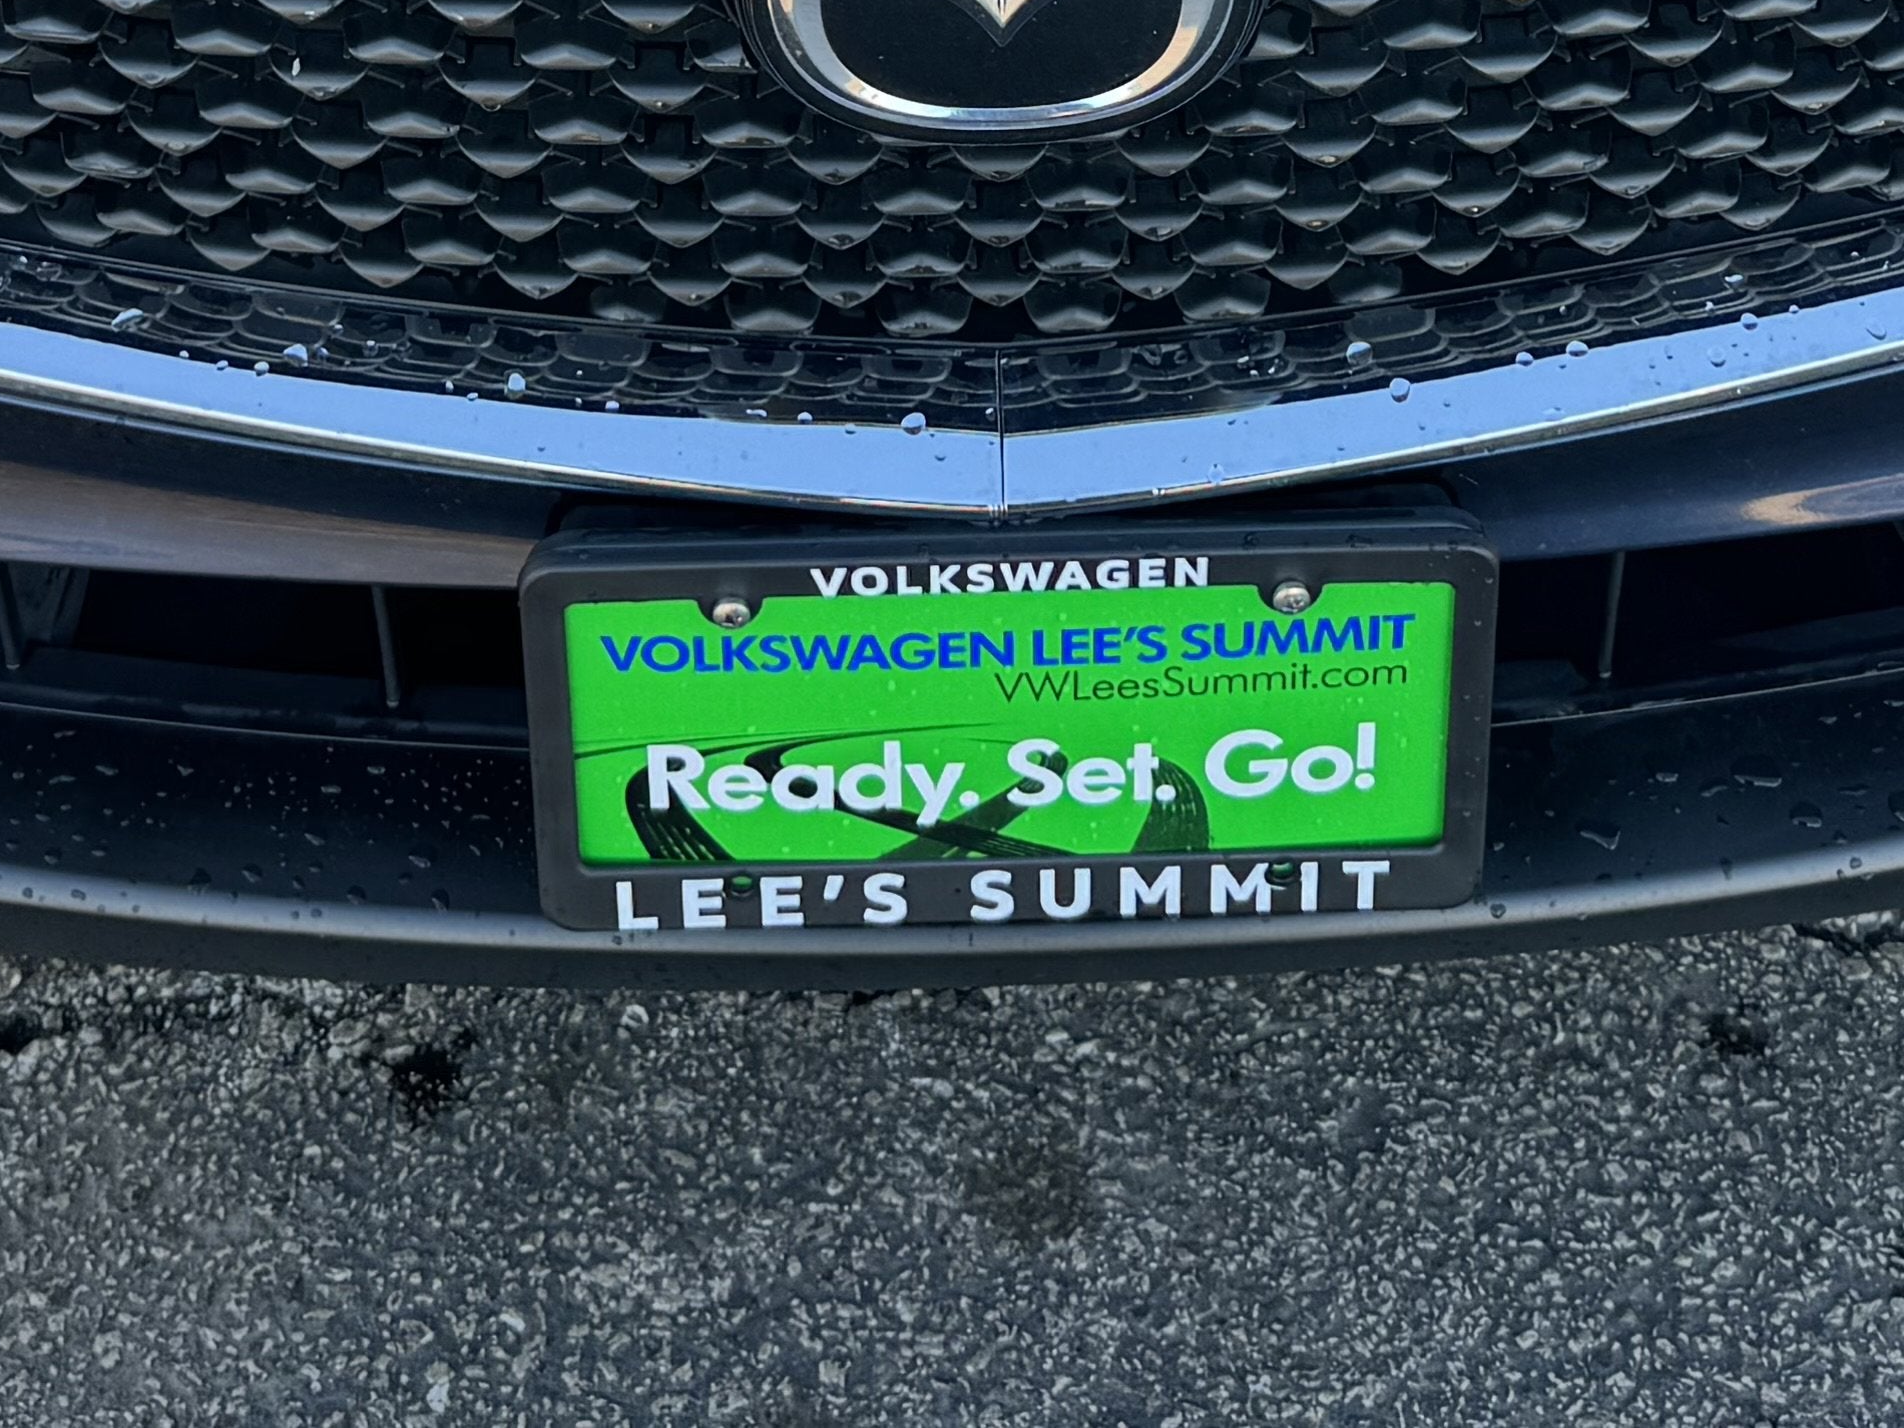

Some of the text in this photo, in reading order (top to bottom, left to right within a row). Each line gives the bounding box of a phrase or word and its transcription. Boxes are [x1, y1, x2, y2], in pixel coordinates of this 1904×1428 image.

[810, 556, 1210, 599] VOLKSWAGEN
[599, 613, 1417, 674] VOLKSWAGEN LEE'S SUMMIT
[993, 662, 1408, 704] VWLeesSummit.com
[645, 721, 1377, 826] Ready. Set. Go!
[615, 860, 1391, 932] LEE'S SUMMIT
